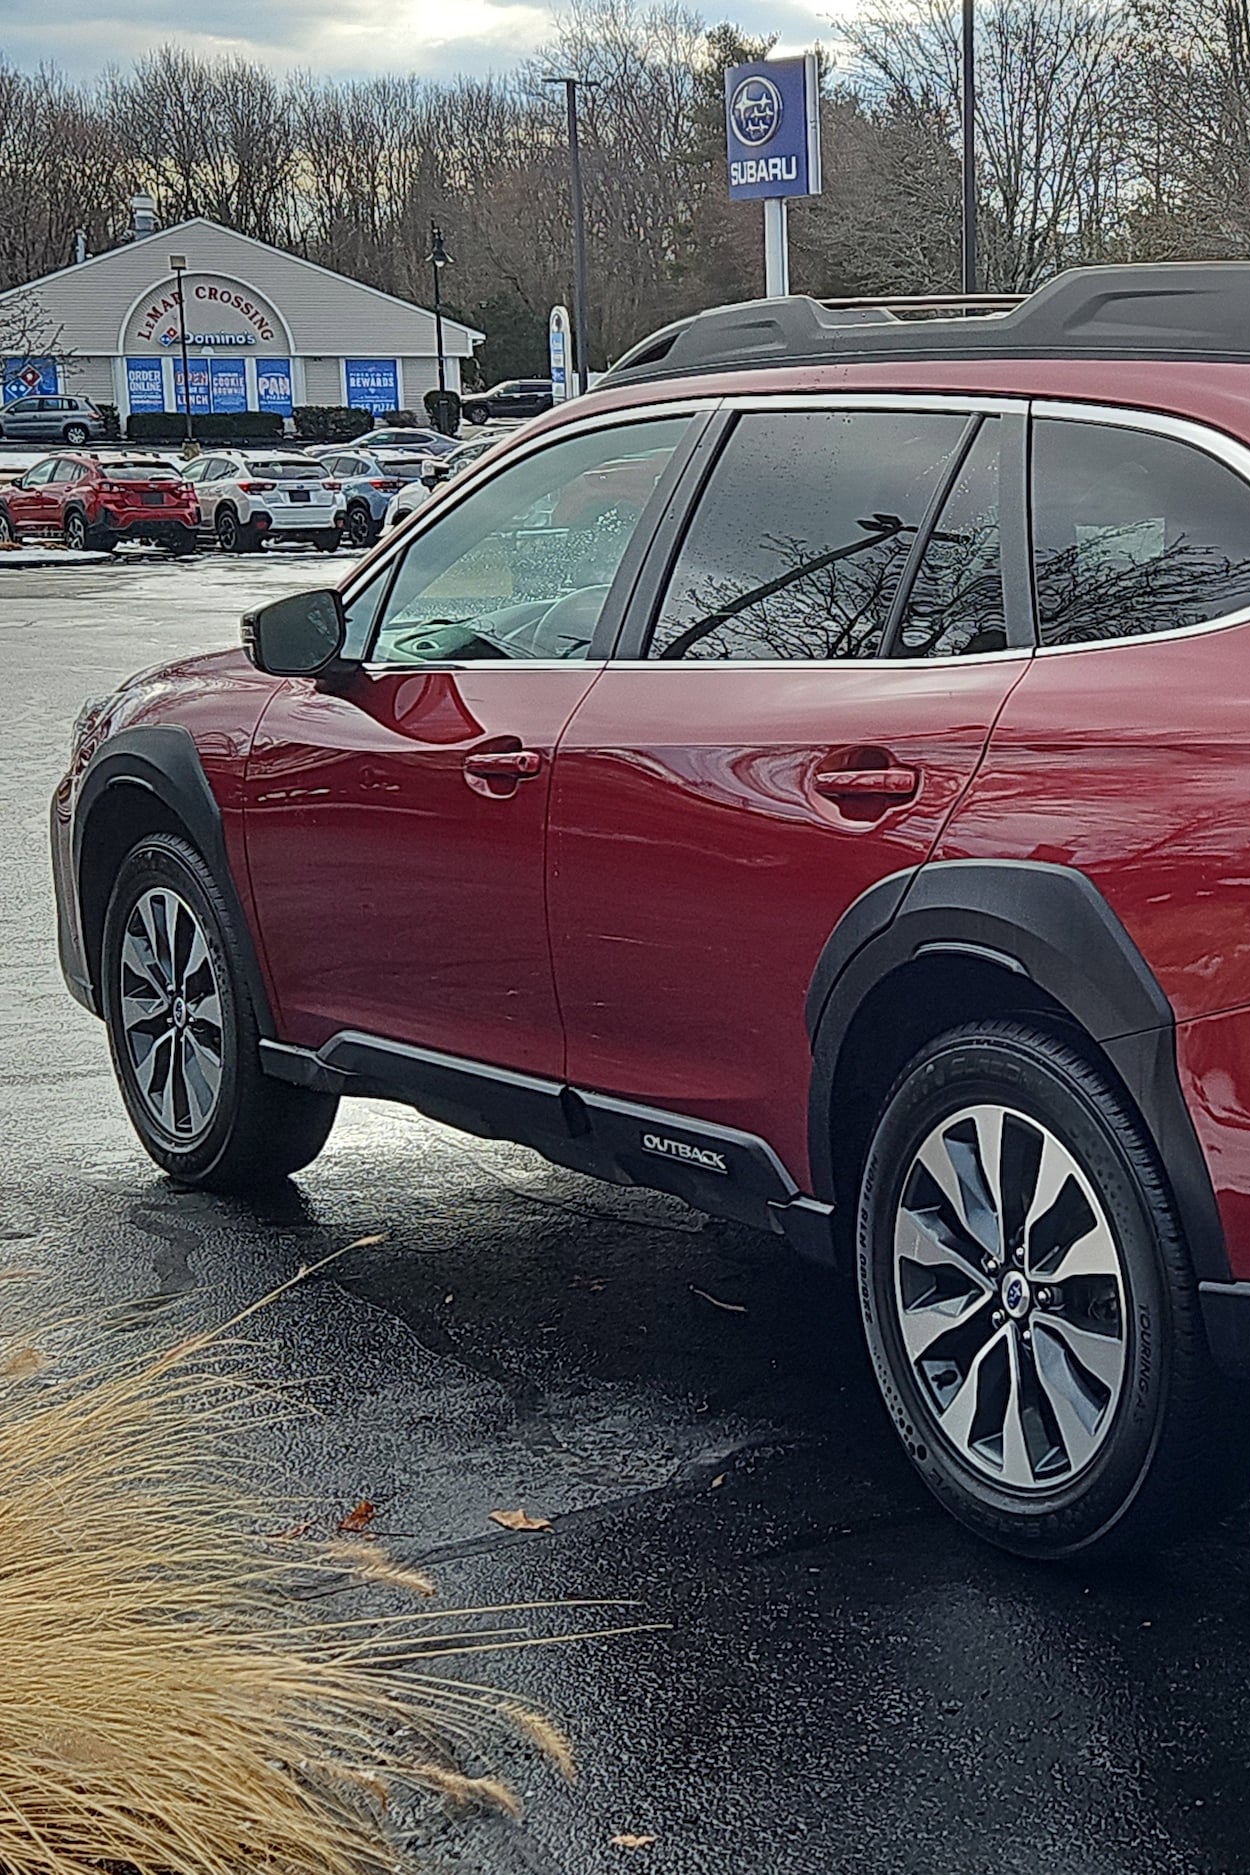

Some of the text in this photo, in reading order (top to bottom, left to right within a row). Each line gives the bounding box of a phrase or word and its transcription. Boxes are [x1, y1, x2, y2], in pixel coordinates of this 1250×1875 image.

[730, 156, 797, 186] SUBARU
[195, 286, 275, 342] CROSSING
[184, 331, 256, 345] Domino's
[128, 370, 161, 382] ORDER
[212, 376, 245, 387] COOKIE
[349, 377, 394, 387] REWARDS
[129, 381, 162, 392] ONLINE
[258, 377, 291, 395] PAN
[643, 1134, 727, 1170] OUTBACK
[1138, 1303, 1154, 1395] TOURING
